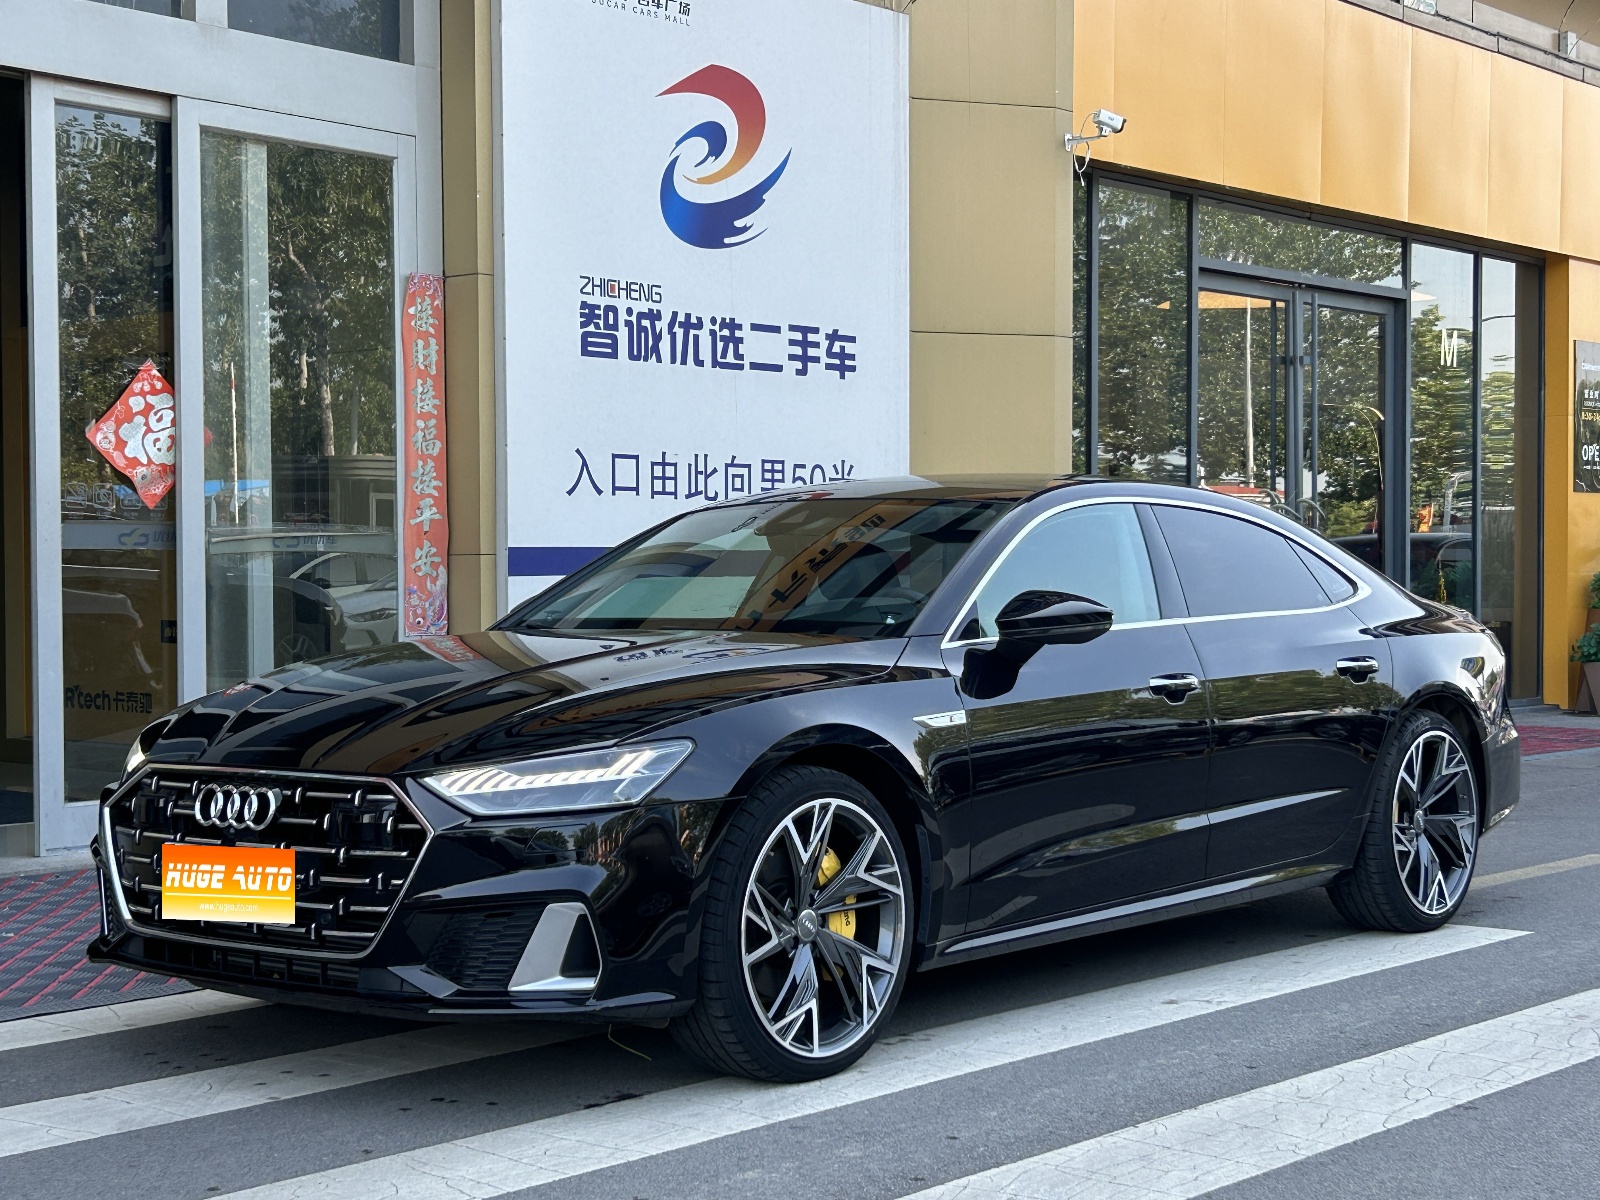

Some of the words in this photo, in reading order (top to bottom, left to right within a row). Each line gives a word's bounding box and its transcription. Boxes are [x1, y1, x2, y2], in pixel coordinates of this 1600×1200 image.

[632, 6, 659, 18] CARS
[664, 13, 691, 26] MALL
[579, 300, 857, 380] 智诚优选二手车
[118, 393, 176, 466] 福
